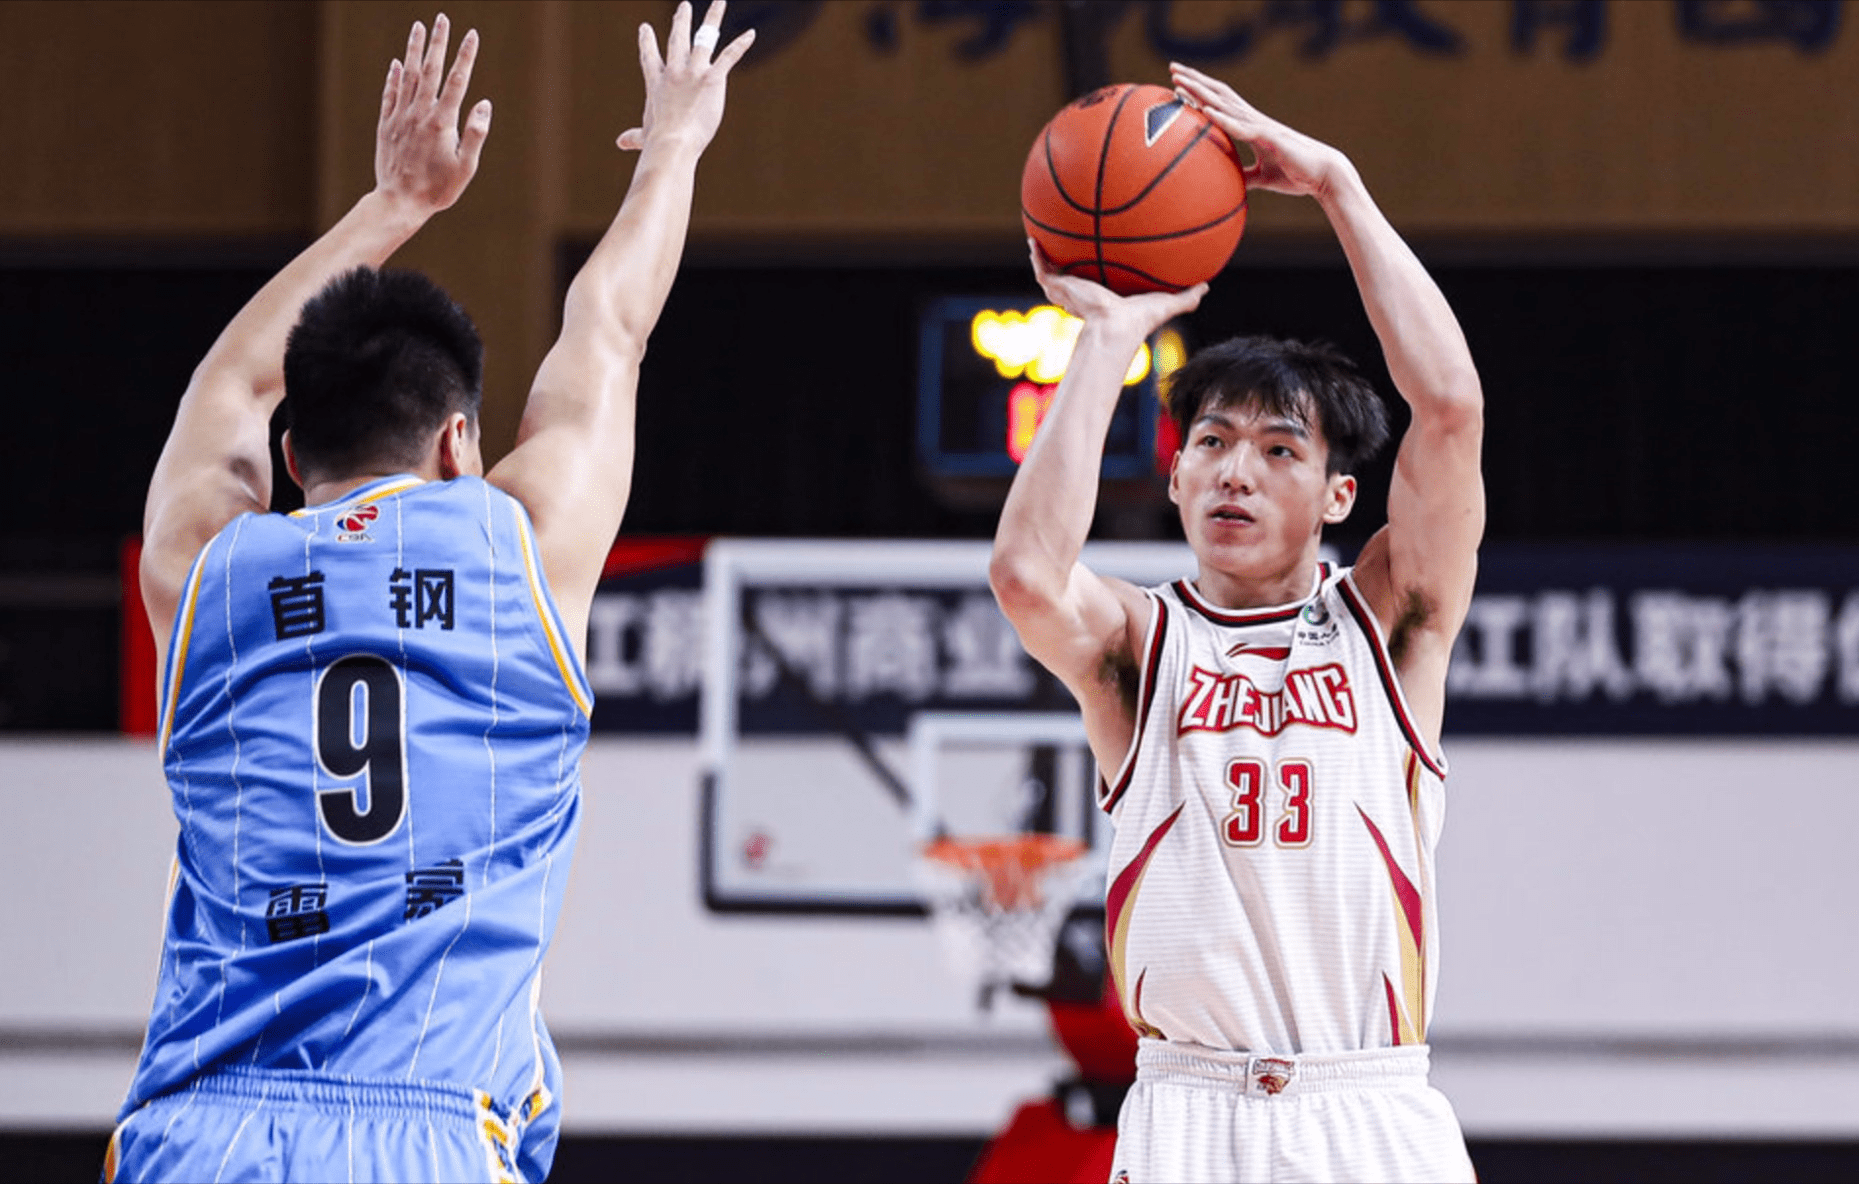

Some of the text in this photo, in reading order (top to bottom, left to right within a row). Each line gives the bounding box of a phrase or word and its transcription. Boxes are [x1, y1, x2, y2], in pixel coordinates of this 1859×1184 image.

[268, 567, 455, 642] 首钢
[1449, 588, 1859, 704] 江队取得
[1178, 662, 1357, 740] ZHEJIANG
[317, 654, 407, 847] 9
[1222, 757, 1314, 850] 33
